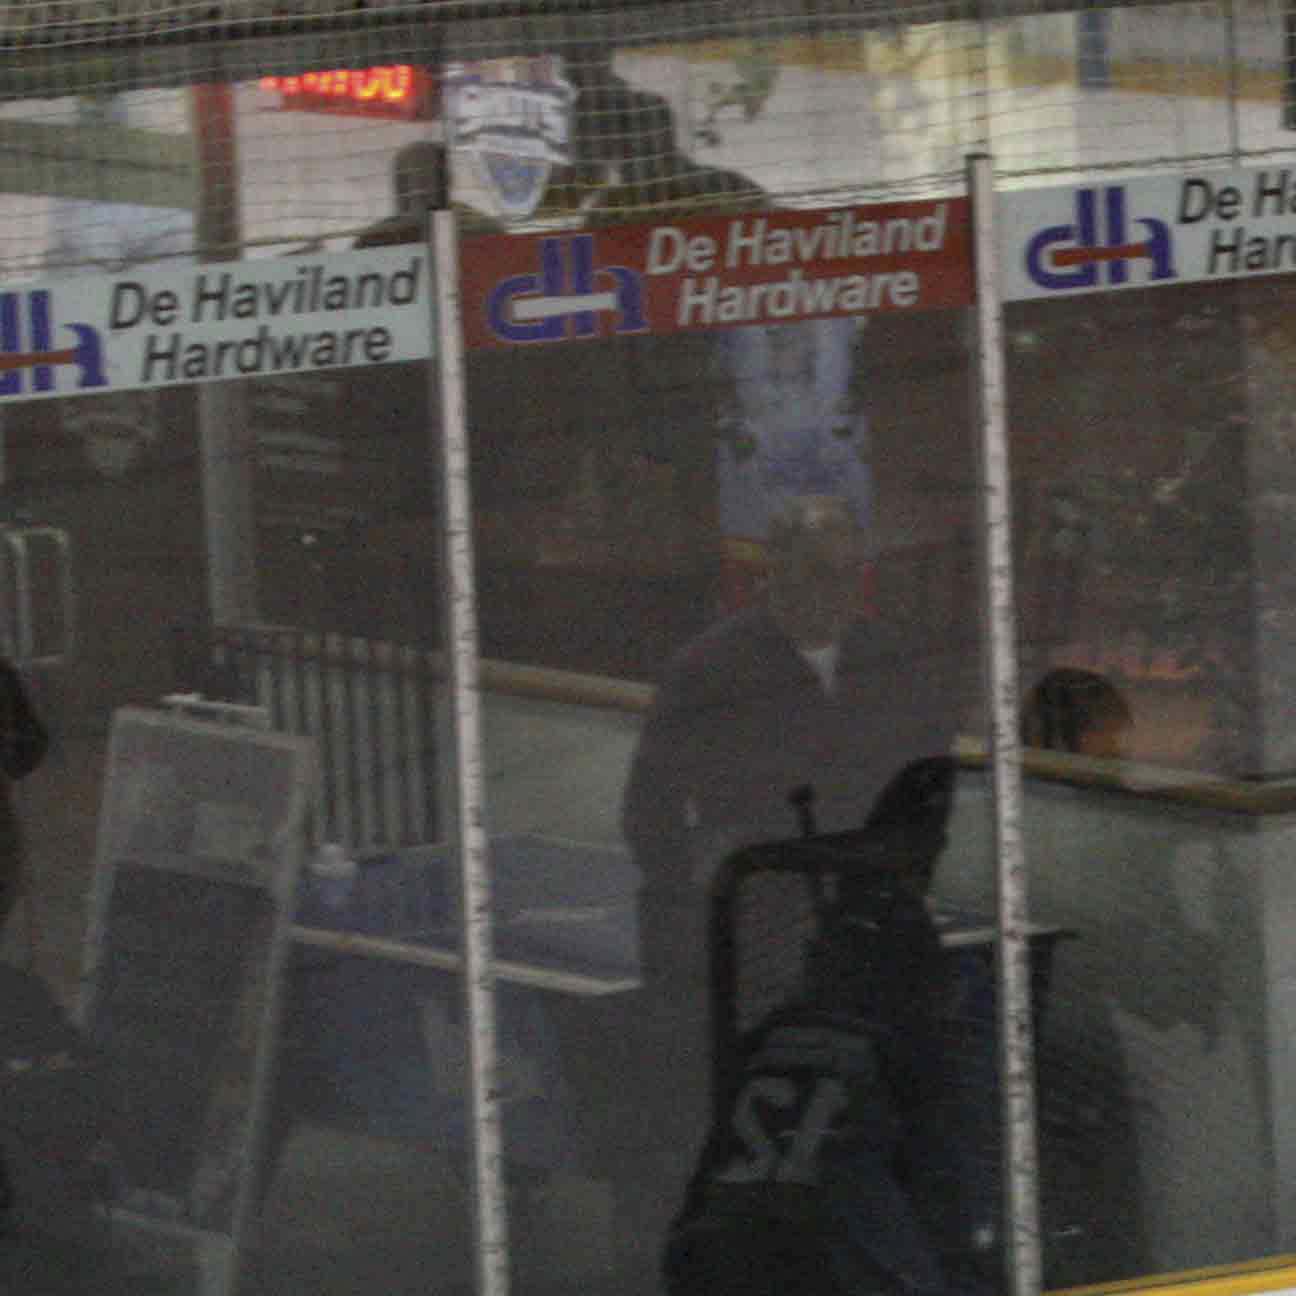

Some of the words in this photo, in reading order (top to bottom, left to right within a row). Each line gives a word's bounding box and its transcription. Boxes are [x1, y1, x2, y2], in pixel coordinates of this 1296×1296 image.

[1177, 178, 1240, 225] De
[646, 226, 715, 276] De
[725, 204, 947, 268] Haviland
[108, 281, 178, 330] De
[191, 258, 424, 323] Haviland
[677, 269, 920, 326] Hardware
[140, 326, 393, 383] Hardware
